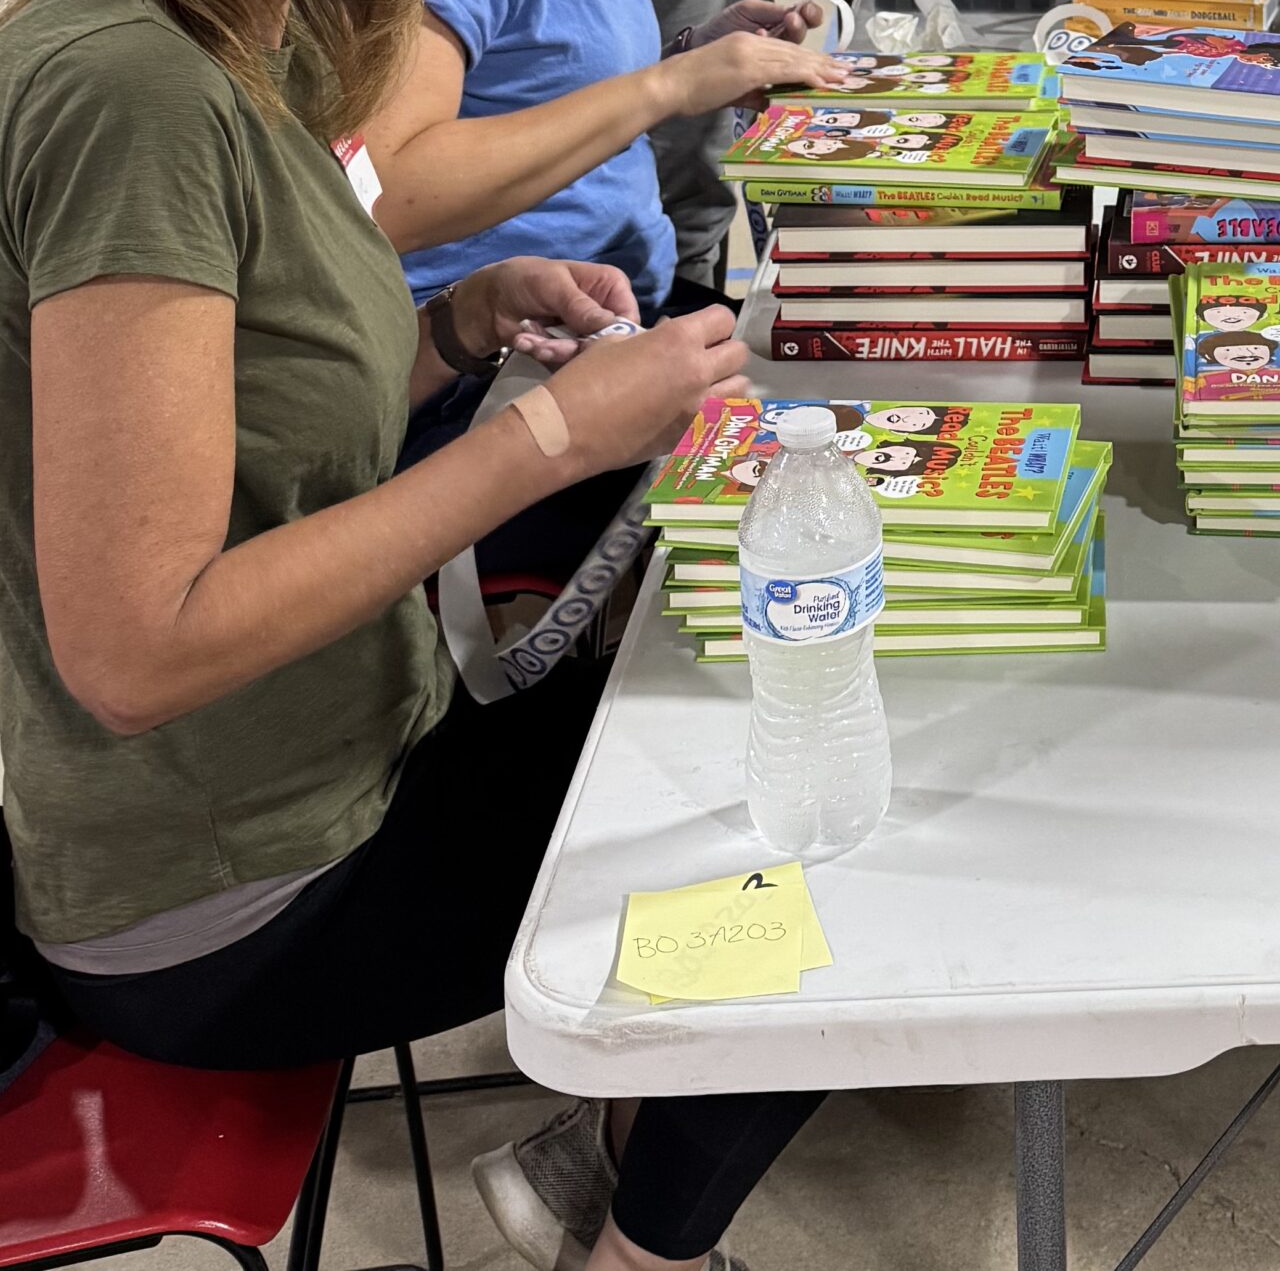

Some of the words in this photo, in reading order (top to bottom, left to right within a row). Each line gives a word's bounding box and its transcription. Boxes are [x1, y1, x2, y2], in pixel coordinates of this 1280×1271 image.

[1190, 11, 1236, 21] DODGEBALL
[760, 189, 776, 197] DAN
[777, 189, 807, 198] GUTMAN
[877, 190, 896, 200] The
[897, 191, 935, 201] BEATLES
[966, 193, 989, 202] Read
[991, 193, 1024, 202] Music?
[1203, 276, 1263, 286] The
[1201, 294, 1278, 304] Read
[855, 337, 926, 359] KNIFE
[954, 336, 1012, 358] HALL
[1231, 373, 1278, 384] DAN
[722, 415, 754, 436] DAN
[936, 406, 973, 441] Read
[997, 408, 1033, 436] The
[694, 437, 742, 481] GUTMAN
[959, 435, 988, 467] Couldn't
[916, 446, 954, 498] Music?
[975, 437, 1026, 499] BEATLES
[1024, 453, 1047, 474] WHAT?
[769, 583, 792, 594] Great
[813, 591, 840, 603] Purified
[794, 601, 840, 615] Drinking
[808, 611, 841, 623] Water
